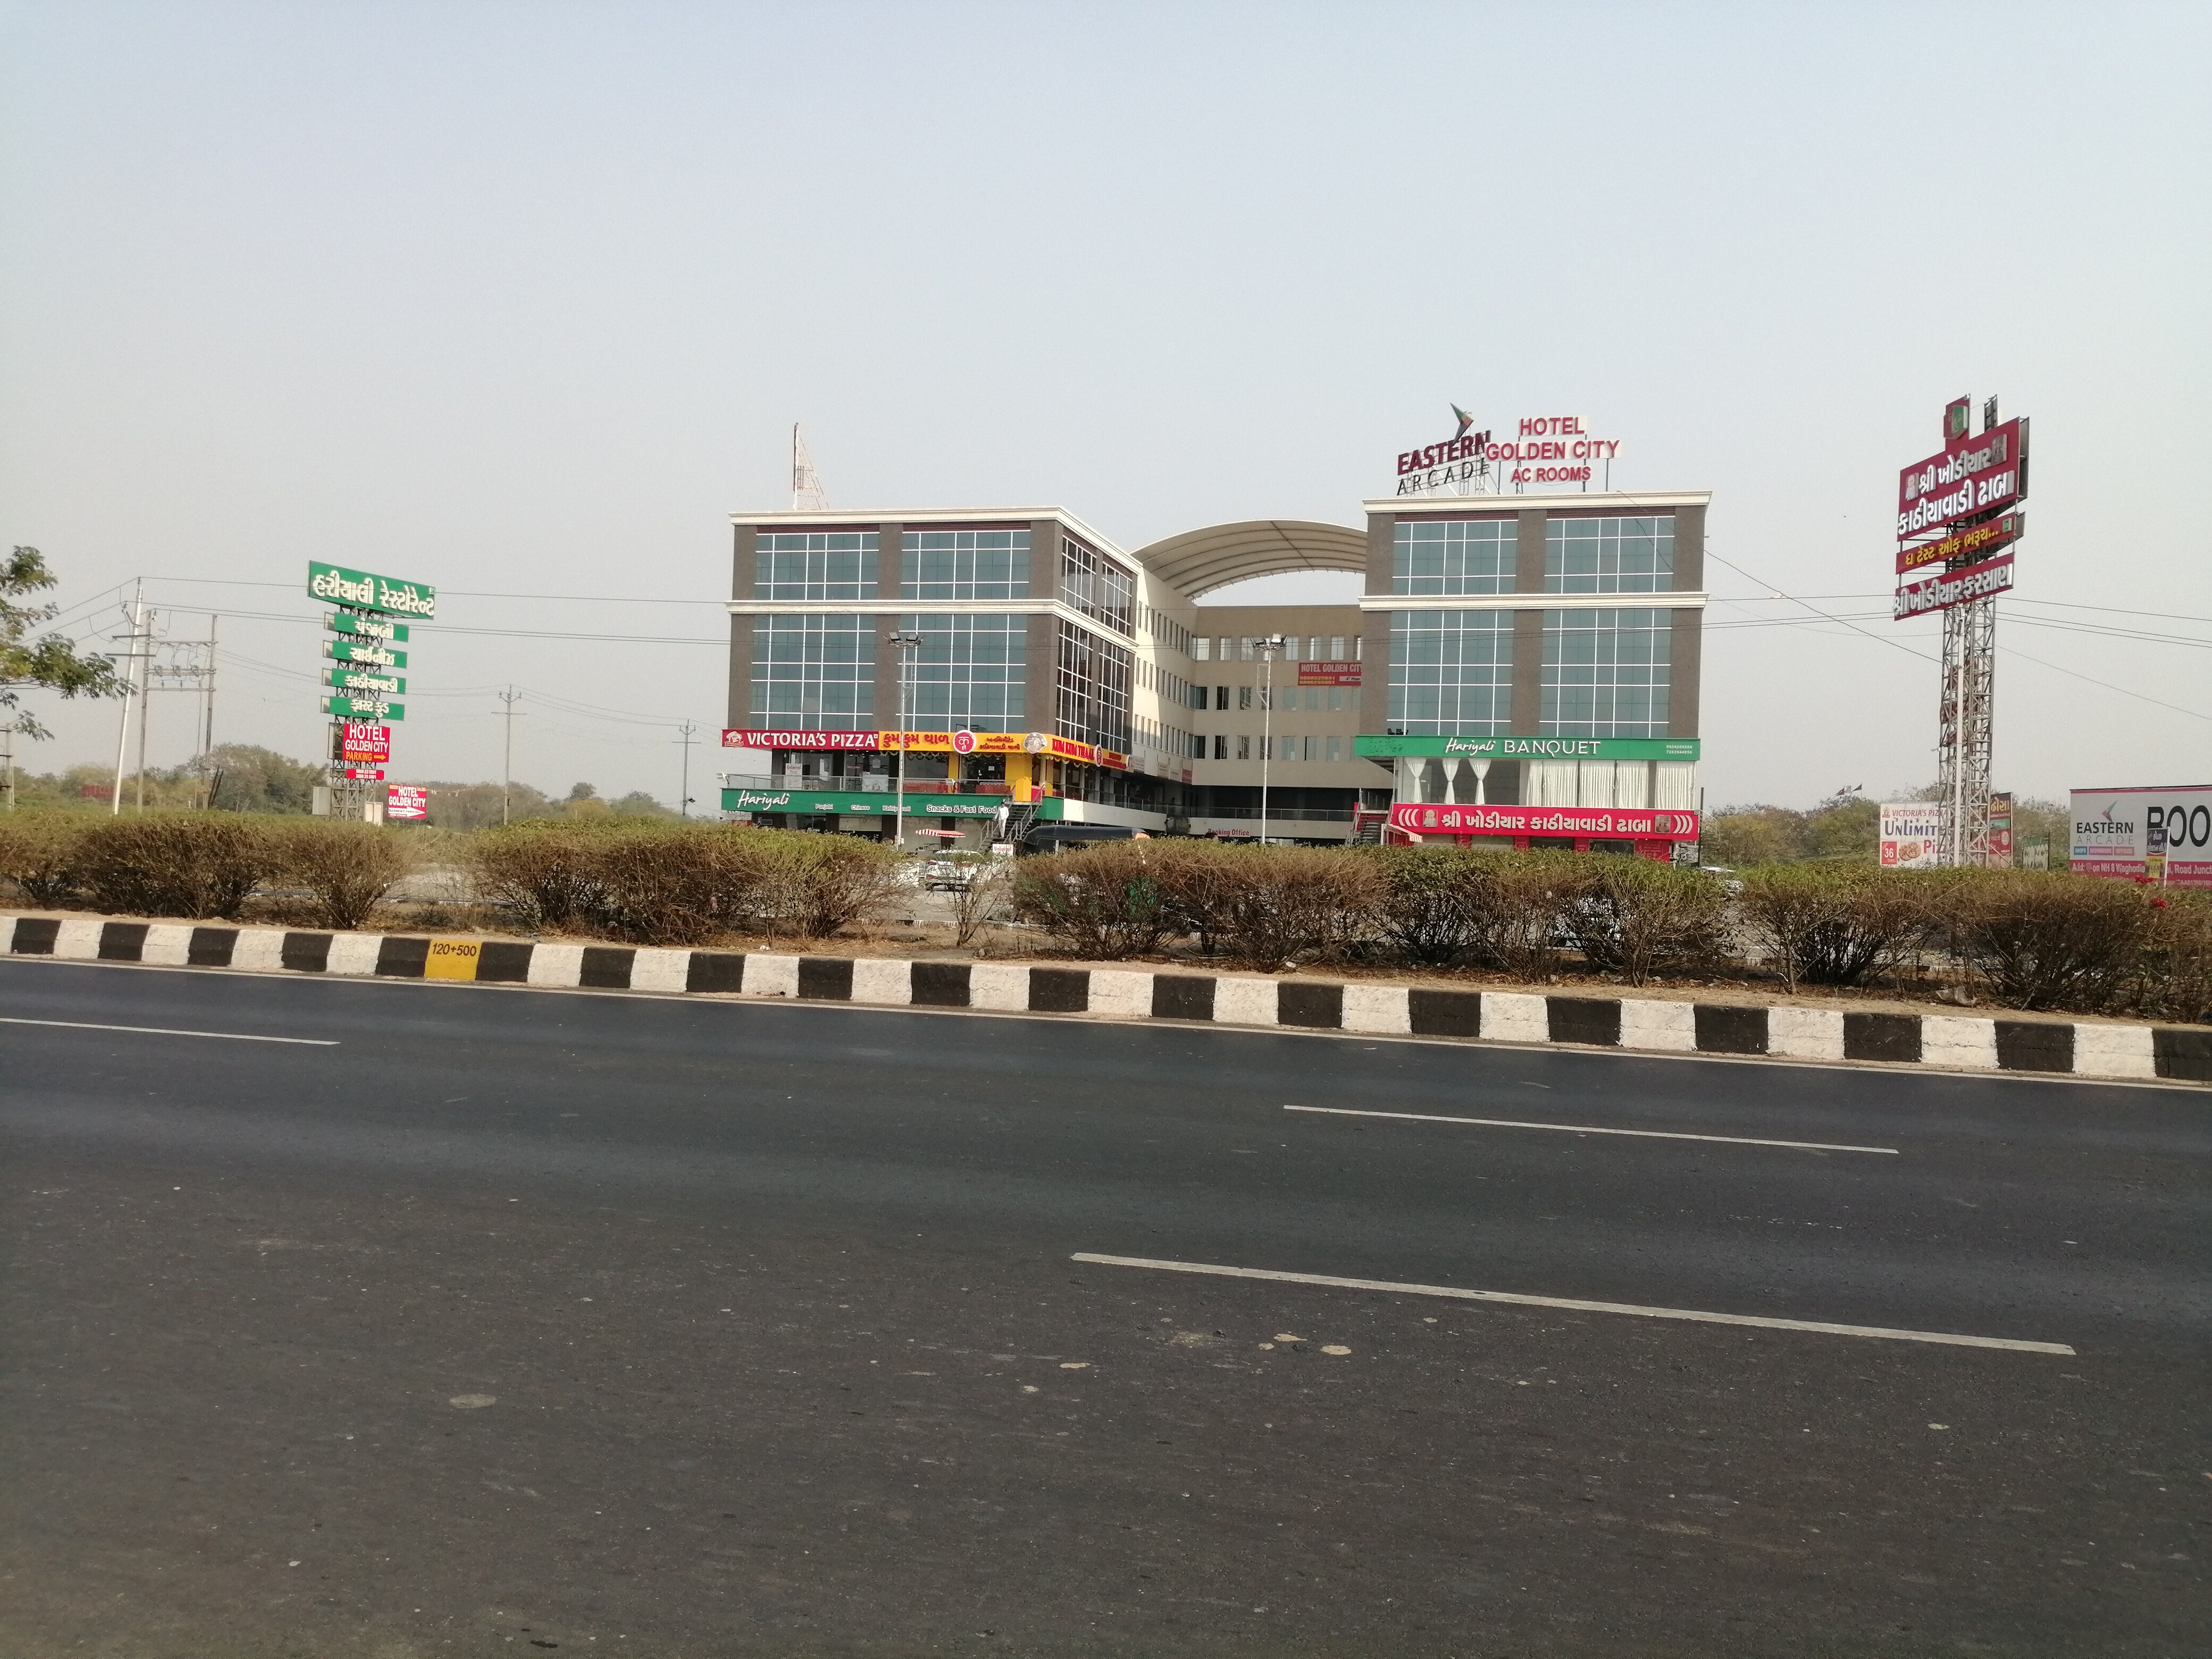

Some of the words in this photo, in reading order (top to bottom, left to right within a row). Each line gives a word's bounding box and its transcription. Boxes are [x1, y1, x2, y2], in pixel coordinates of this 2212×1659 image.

[1520, 417, 1586, 435] HOTEL
[1397, 430, 1491, 475] EASTERN
[1486, 441, 1566, 461] GOLDEN
[1573, 440, 1620, 458] CITY
[1396, 458, 1490, 496] ARCADE
[1511, 468, 1531, 483] AC
[1536, 466, 1591, 482] ROOMS
[1918, 464, 1937, 495] શ્રી
[1938, 448, 1992, 484] ખોડીયાર
[313, 570, 374, 605] હરીયાલી
[1892, 588, 1911, 616] શ્રી
[1301, 664, 1321, 672] HOTEL
[1322, 664, 1348, 672] GOLDEN
[349, 724, 386, 741] HOTEL
[747, 732, 826, 747] VICTORIA'S
[831, 734, 875, 747] PIZZA
[345, 740, 373, 752] GOLDEN
[373, 742, 389, 753] CITY
[1446, 737, 1496, 756] Hariyali
[1504, 740, 1601, 758] BANQUET
[346, 751, 373, 761] PARKING
[398, 785, 418, 798] HOTEL
[389, 795, 412, 806] GOLDEN
[413, 798, 426, 808] CITY
[736, 790, 790, 811] Hariyali
[926, 804, 952, 812] Snacks
[960, 805, 976, 814] Fast
[978, 806, 997, 814] Food
[1442, 810, 1461, 828] શ્રી
[1465, 810, 1526, 830] ખોડીયાર
[1530, 812, 1612, 832] કાઠીયાવાડી
[1616, 818, 1651, 833] ઢાબા
[2076, 822, 2134, 834] EASTERN
[2076, 835, 2134, 845] ARCADE
[1884, 848, 1894, 858] 36
[2072, 862, 2084, 872] Add:
[2101, 863, 2110, 872] NH
[2111, 862, 2115, 872] 8
[2116, 863, 2146, 875] Waghodia
[2174, 864, 2192, 874] Road
[433, 942, 477, 957] 120+500
